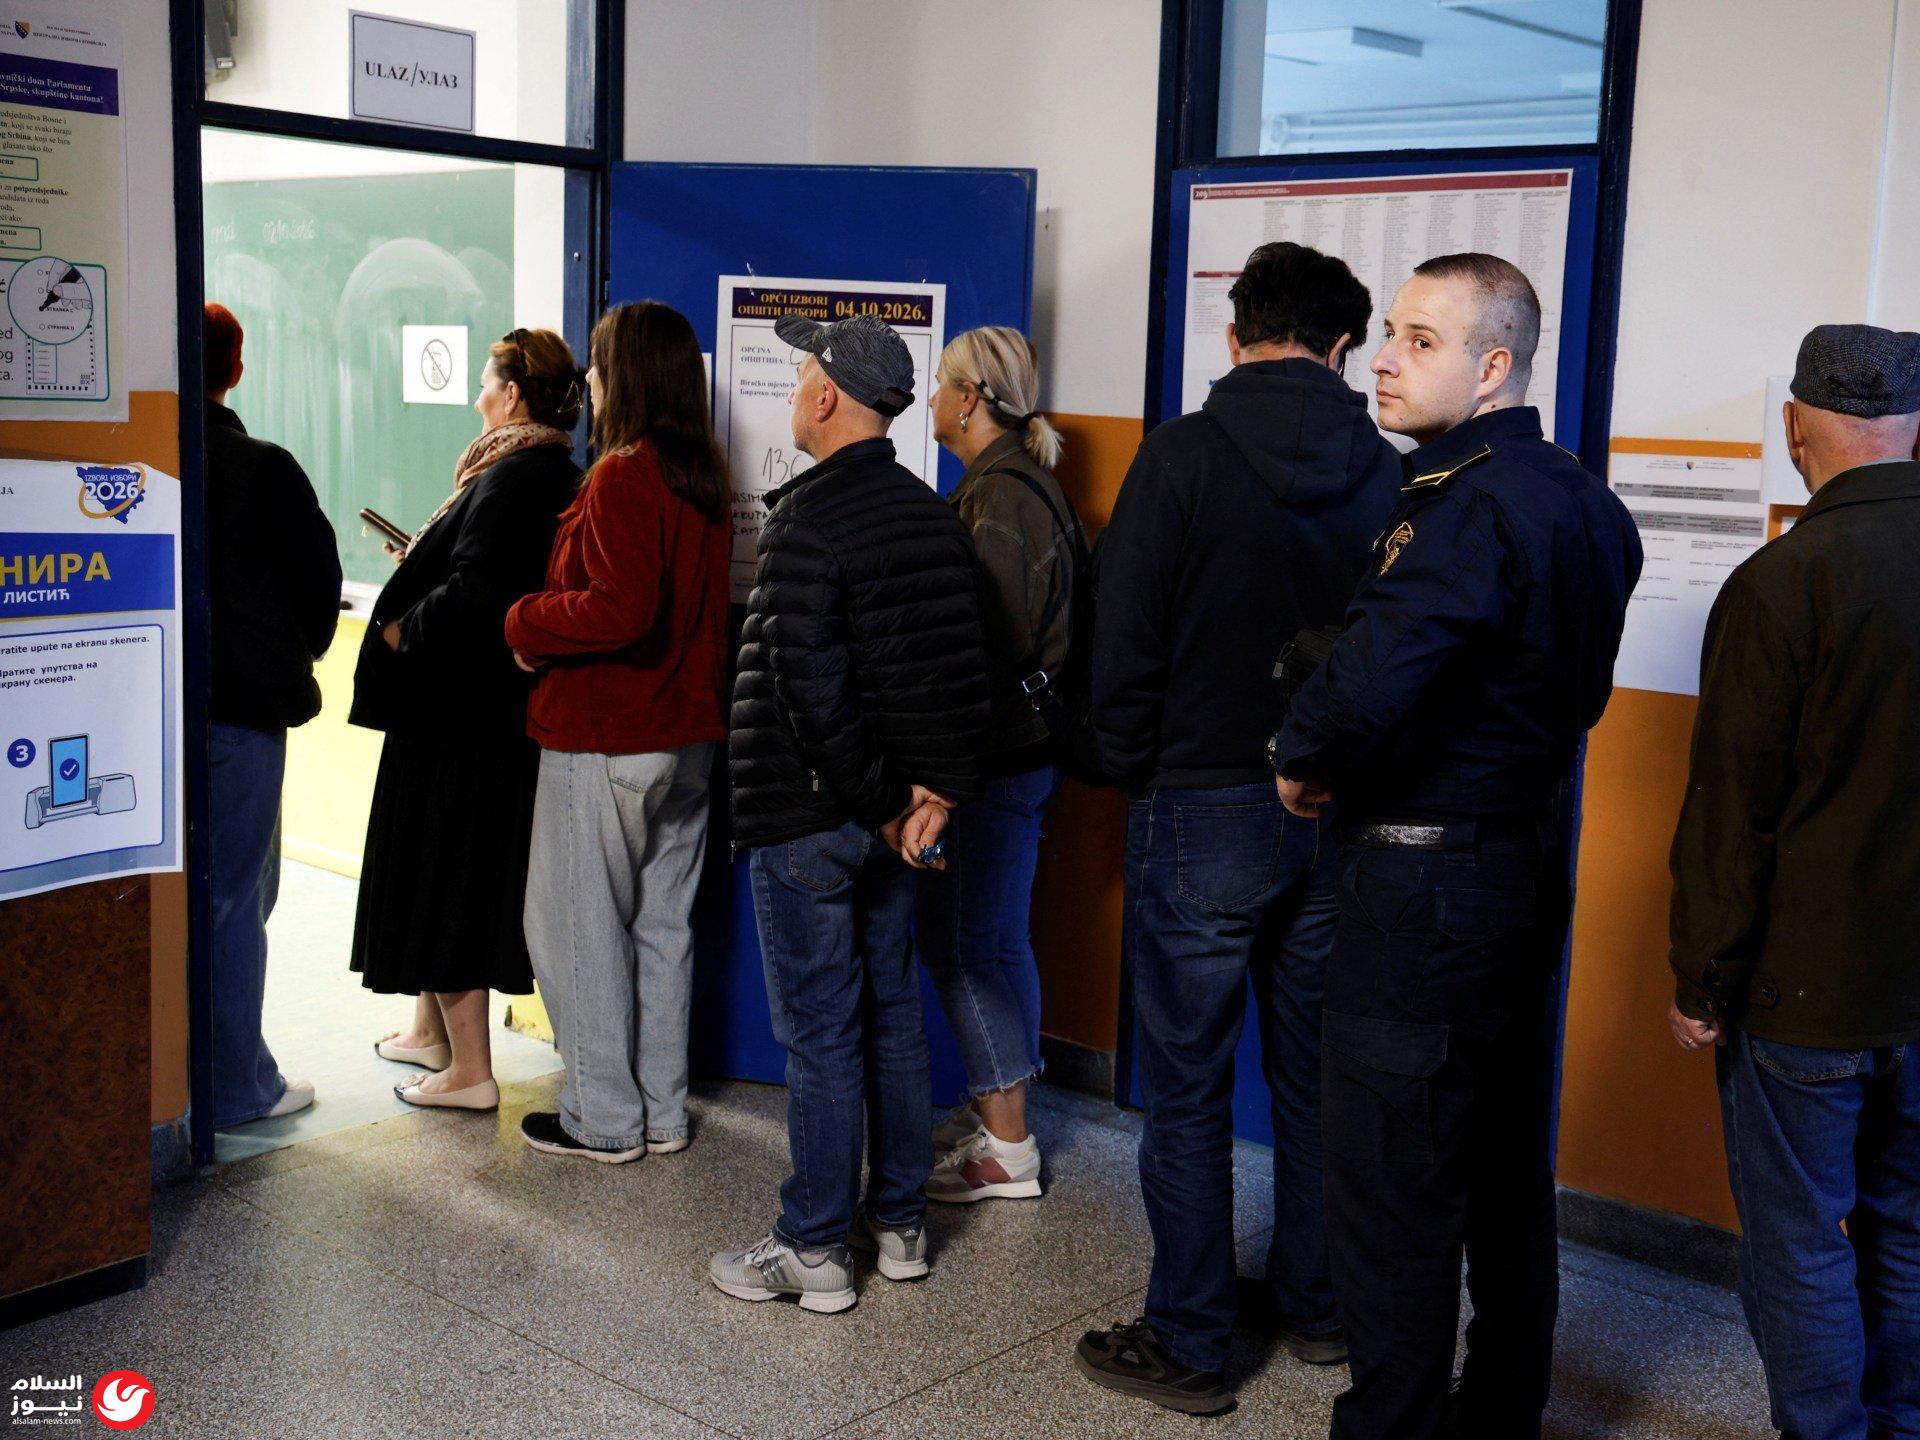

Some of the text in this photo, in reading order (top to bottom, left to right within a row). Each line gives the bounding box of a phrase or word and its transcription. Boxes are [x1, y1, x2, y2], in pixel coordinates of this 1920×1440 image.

[365, 61, 458, 89] ULAZ/УЛАЗ
[28, 76, 45, 85] dom
[47, 79, 91, 92] Parlamenta
[0, 83, 104, 103] Srpske, skupštine kantona!
[13, 184, 69, 196] potpredsjednike
[760, 292, 828, 306] OPĆI IZBORI
[738, 304, 782, 317] ОПШТИ
[835, 300, 927, 320] 04.10.2026.
[741, 345, 771, 354] OPĆINA
[740, 379, 766, 387] Biračko
[767, 381, 790, 389] mjesto
[740, 388, 769, 398] Бирачко
[84, 474, 138, 482] IZBORI ИЗБОРИ
[85, 481, 140, 501] 2026
[0, 551, 112, 586] НИРА
[3, 588, 70, 604] ЛИСТИЋ
[30, 643, 59, 654] upute
[61, 642, 73, 650] na
[75, 639, 108, 648] ekranu
[110, 635, 150, 645] skenera.
[41, 662, 84, 675] упутства
[86, 661, 98, 669] на
[33, 674, 76, 685] скенера.
[15, 745, 29, 762] 3
